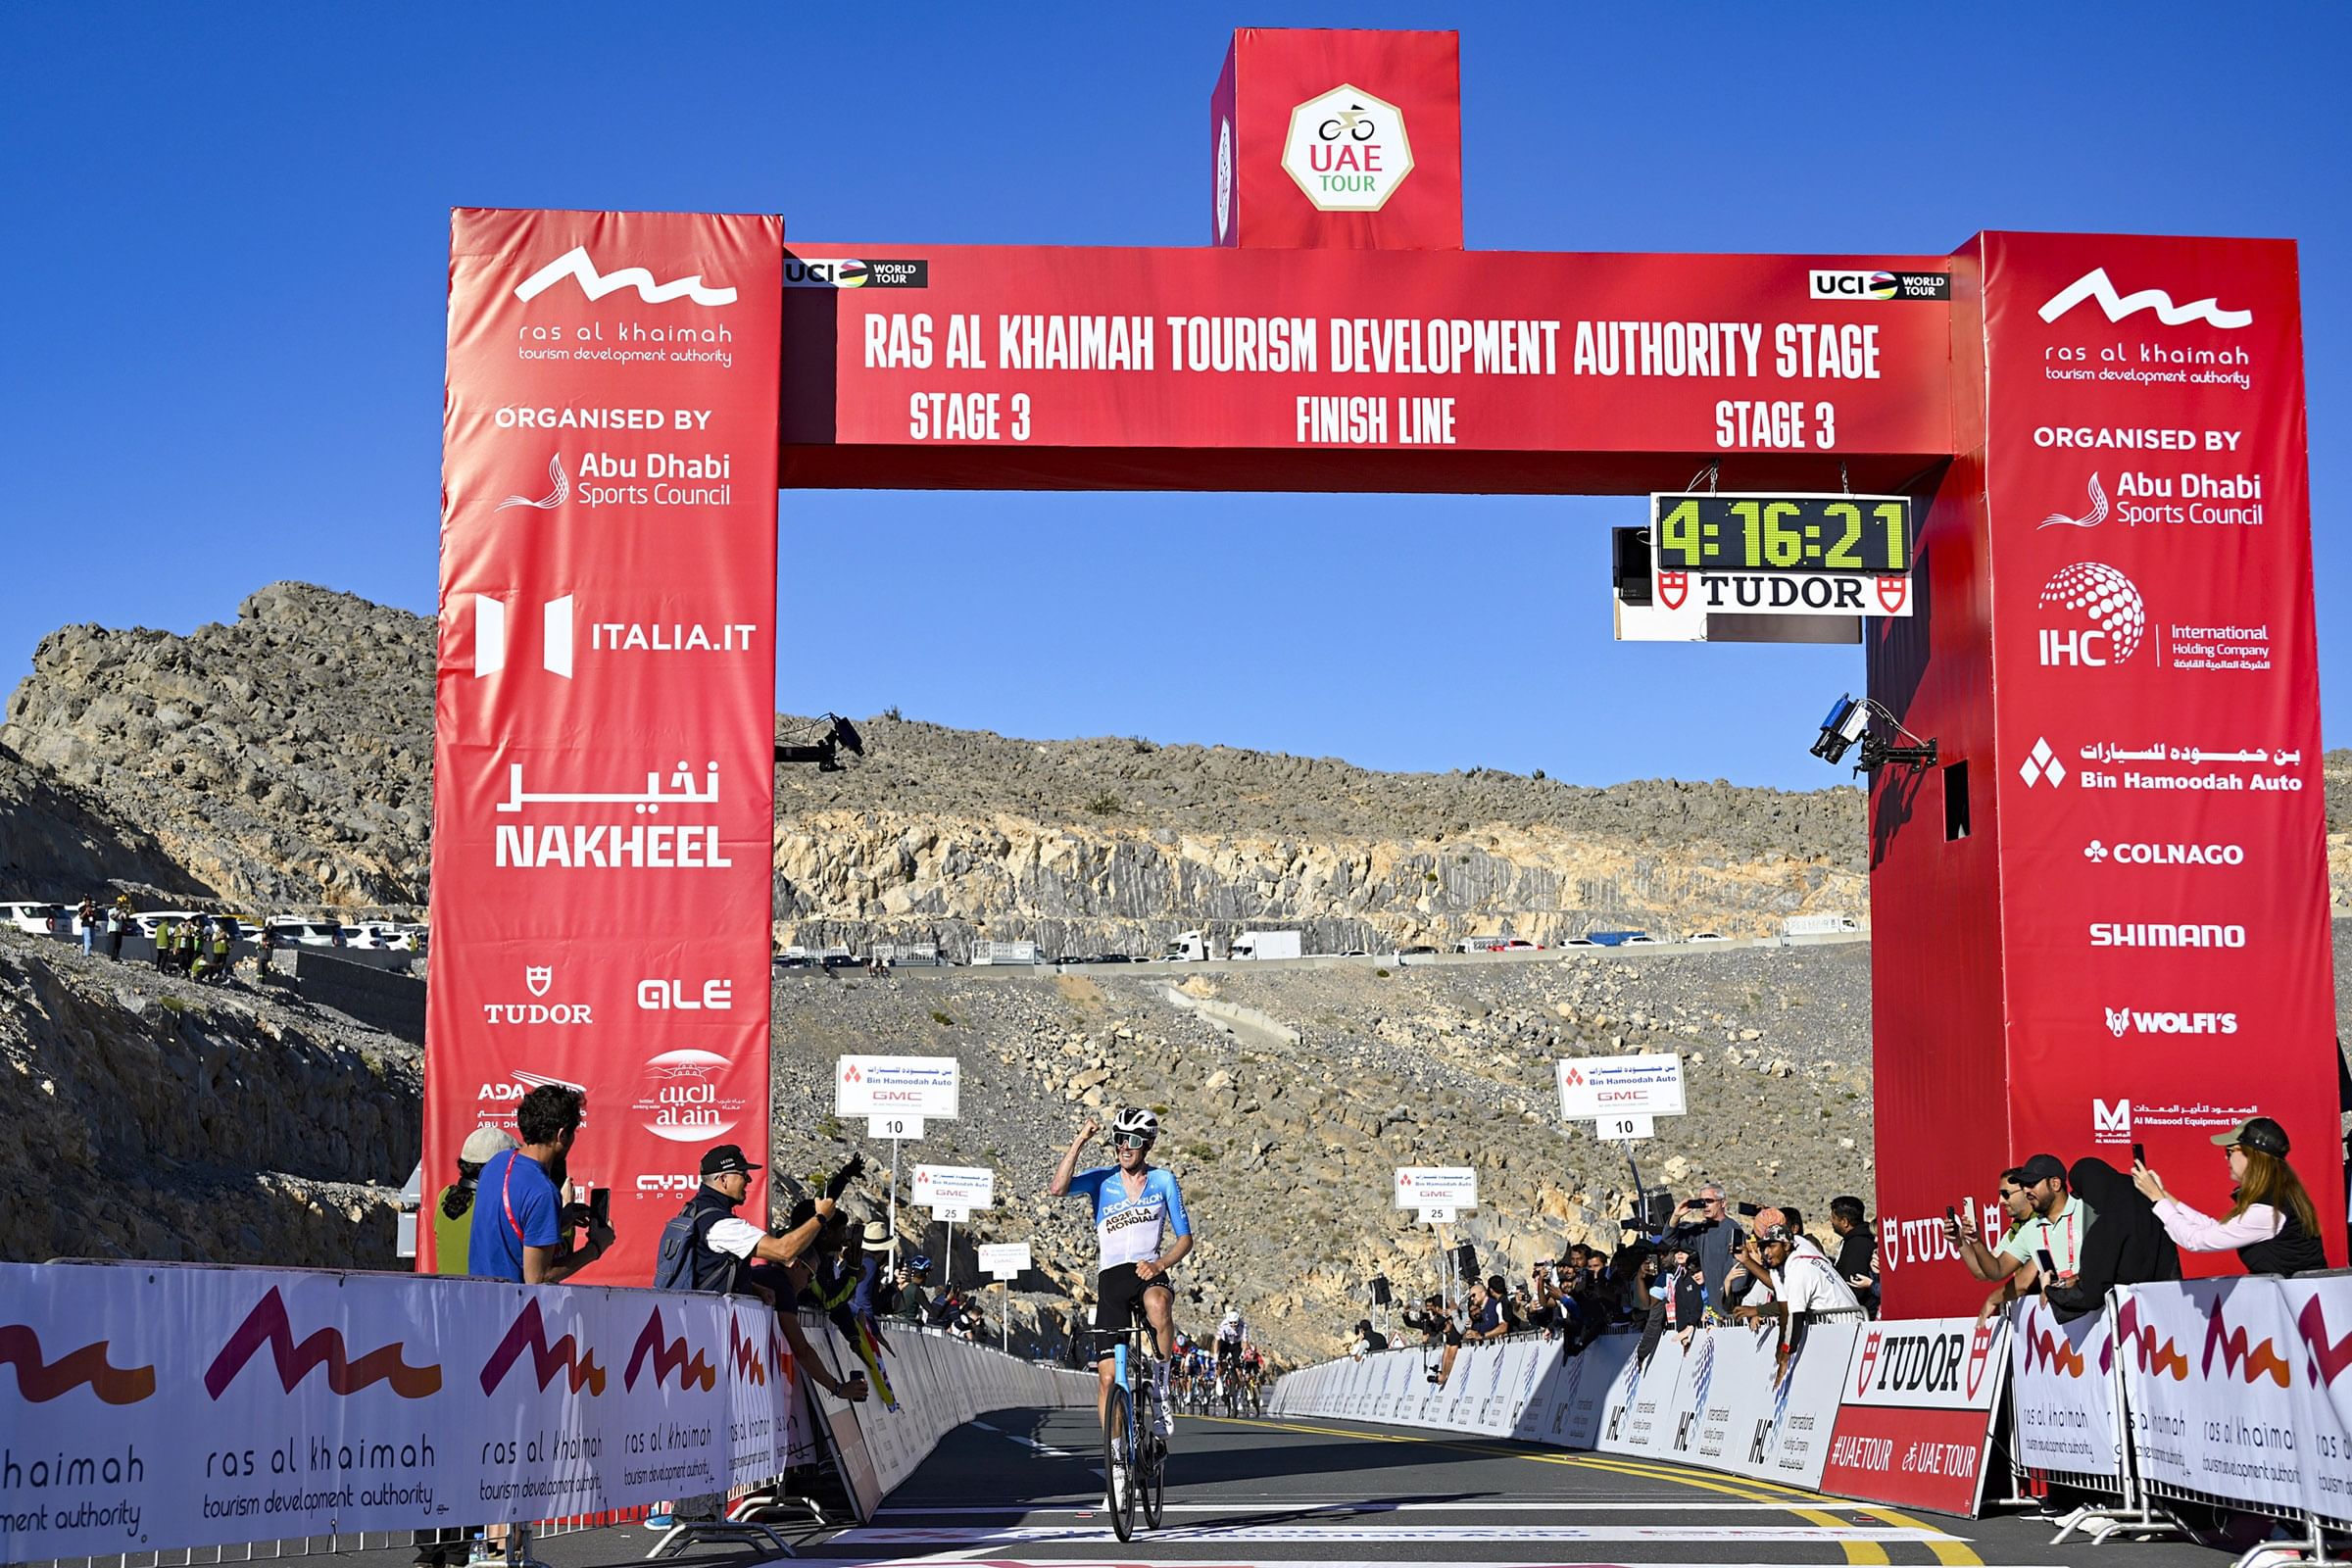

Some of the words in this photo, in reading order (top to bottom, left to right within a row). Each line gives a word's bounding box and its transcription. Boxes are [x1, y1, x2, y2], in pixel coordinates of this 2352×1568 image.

[1309, 145, 1383, 172] UAE
[1319, 174, 1376, 192] TOUR
[785, 264, 832, 282] UCI
[873, 264, 916, 274] WORLD
[874, 273, 906, 283] TOUR
[1816, 275, 1864, 295] UCI
[1902, 276, 1944, 287] WORLD
[1904, 286, 1936, 297] TOUR
[519, 325, 562, 341] ras
[577, 321, 603, 341] al
[619, 321, 732, 343] khaimah
[518, 348, 569, 360] tourism
[573, 348, 665, 365] development
[670, 350, 732, 368] authority
[864, 314, 933, 368] RAS
[946, 314, 986, 368] AL
[1000, 315, 1153, 370] KHAIMAH
[1167, 317, 1317, 372] TOURISM
[1330, 318, 1560, 375] DEVELOPMENT
[1574, 320, 1762, 377] AUTHORITY
[1776, 323, 1881, 378] STAGE
[2045, 346, 2085, 361] ras
[2100, 343, 2127, 362] al
[2141, 344, 2249, 365] khaimah
[2046, 368, 2094, 380] tourism
[2098, 368, 2186, 385] development
[2189, 372, 2250, 390] authority
[495, 408, 664, 429] ORGANISED
[674, 410, 711, 430] BY
[909, 392, 1001, 440] STAGE
[1011, 393, 1031, 440] 3
[1296, 396, 1388, 443] FINISH
[1398, 397, 1455, 444] LINE
[1715, 400, 1805, 448] STAGE
[1815, 401, 1835, 450] 3
[2034, 427, 2196, 450] ORGANISED
[2205, 431, 2241, 451] BY
[578, 453, 636, 477] Abu
[647, 453, 730, 479] Dhabi
[578, 482, 648, 508] Sports
[654, 483, 730, 506] Council
[2117, 471, 2172, 498] Abu
[2180, 473, 2261, 499] Dhabi
[2117, 501, 2183, 526] Sports
[2188, 503, 2263, 525] Council
[1661, 500, 1903, 569] 4:16:21
[1701, 576, 1866, 609] TUDOR
[592, 623, 757, 651] ITALIA.IT
[2172, 624, 2269, 640] International
[2038, 629, 2106, 666] IHC
[2173, 643, 2215, 658] Holding
[2217, 644, 2269, 659] Company
[2273, 748, 2301, 765] بن
[2081, 771, 2117, 789] Bin
[2125, 772, 2243, 790] Hamoodah
[2249, 774, 2302, 791] Auto
[495, 825, 732, 868] NAKHEEL
[2113, 844, 2243, 864] COLNAGO
[2089, 923, 2245, 948] SHIMANO
[483, 1004, 593, 1024] TUDOR
[477, 1083, 525, 1101] ADA
[883, 1077, 929, 1086] Hamoodah
[660, 1083, 715, 1107] العين
[872, 1091, 922, 1101] GMC
[1597, 1091, 1648, 1102] GMC
[657, 1106, 678, 1125] al
[681, 1105, 721, 1125] ain
[886, 1120, 904, 1134] 10
[1616, 1120, 1634, 1134] 10
[2133, 1116, 2143, 1125] Al
[2184, 1117, 2230, 1127] Equipment
[945, 1209, 956, 1218] 25
[1105, 1210, 1133, 1227] AG2R
[1107, 1214, 1159, 1234] MONDIALE
[1431, 1209, 1444, 1218] 25
[1877, 1334, 1965, 1393] TUDOR
[2048, 1403, 2088, 1429] khaimah
[624, 1433, 644, 1453] ras
[651, 1422, 662, 1451] al
[667, 1419, 711, 1449] khaimah
[1674, 1411, 1694, 1451] IHC
[1748, 1419, 1773, 1464] IHC
[2204, 1420, 2221, 1443] ras
[2224, 1415, 2232, 1444] al
[207, 1450, 255, 1478] ras
[270, 1437, 296, 1474] al
[311, 1433, 435, 1471] khaimah
[482, 1442, 516, 1465] ras
[527, 1431, 544, 1462] al
[553, 1427, 603, 1461] khaimah
[1831, 1436, 1893, 1471] #UAETOUR
[2316, 1434, 2337, 1458] ras
[3, 1445, 144, 1489] haimah
[1917, 1443, 1944, 1474] UAE
[1944, 1445, 1977, 1478] TOUR
[624, 1466, 648, 1486] tourism
[649, 1459, 686, 1488] development
[2318, 1471, 2344, 1495] tourism
[479, 1479, 519, 1501] tourism
[521, 1473, 574, 1502] development
[203, 1494, 260, 1518] tourism
[265, 1484, 354, 1519] development
[361, 1482, 433, 1515] authority
[56, 1499, 141, 1538] authority
